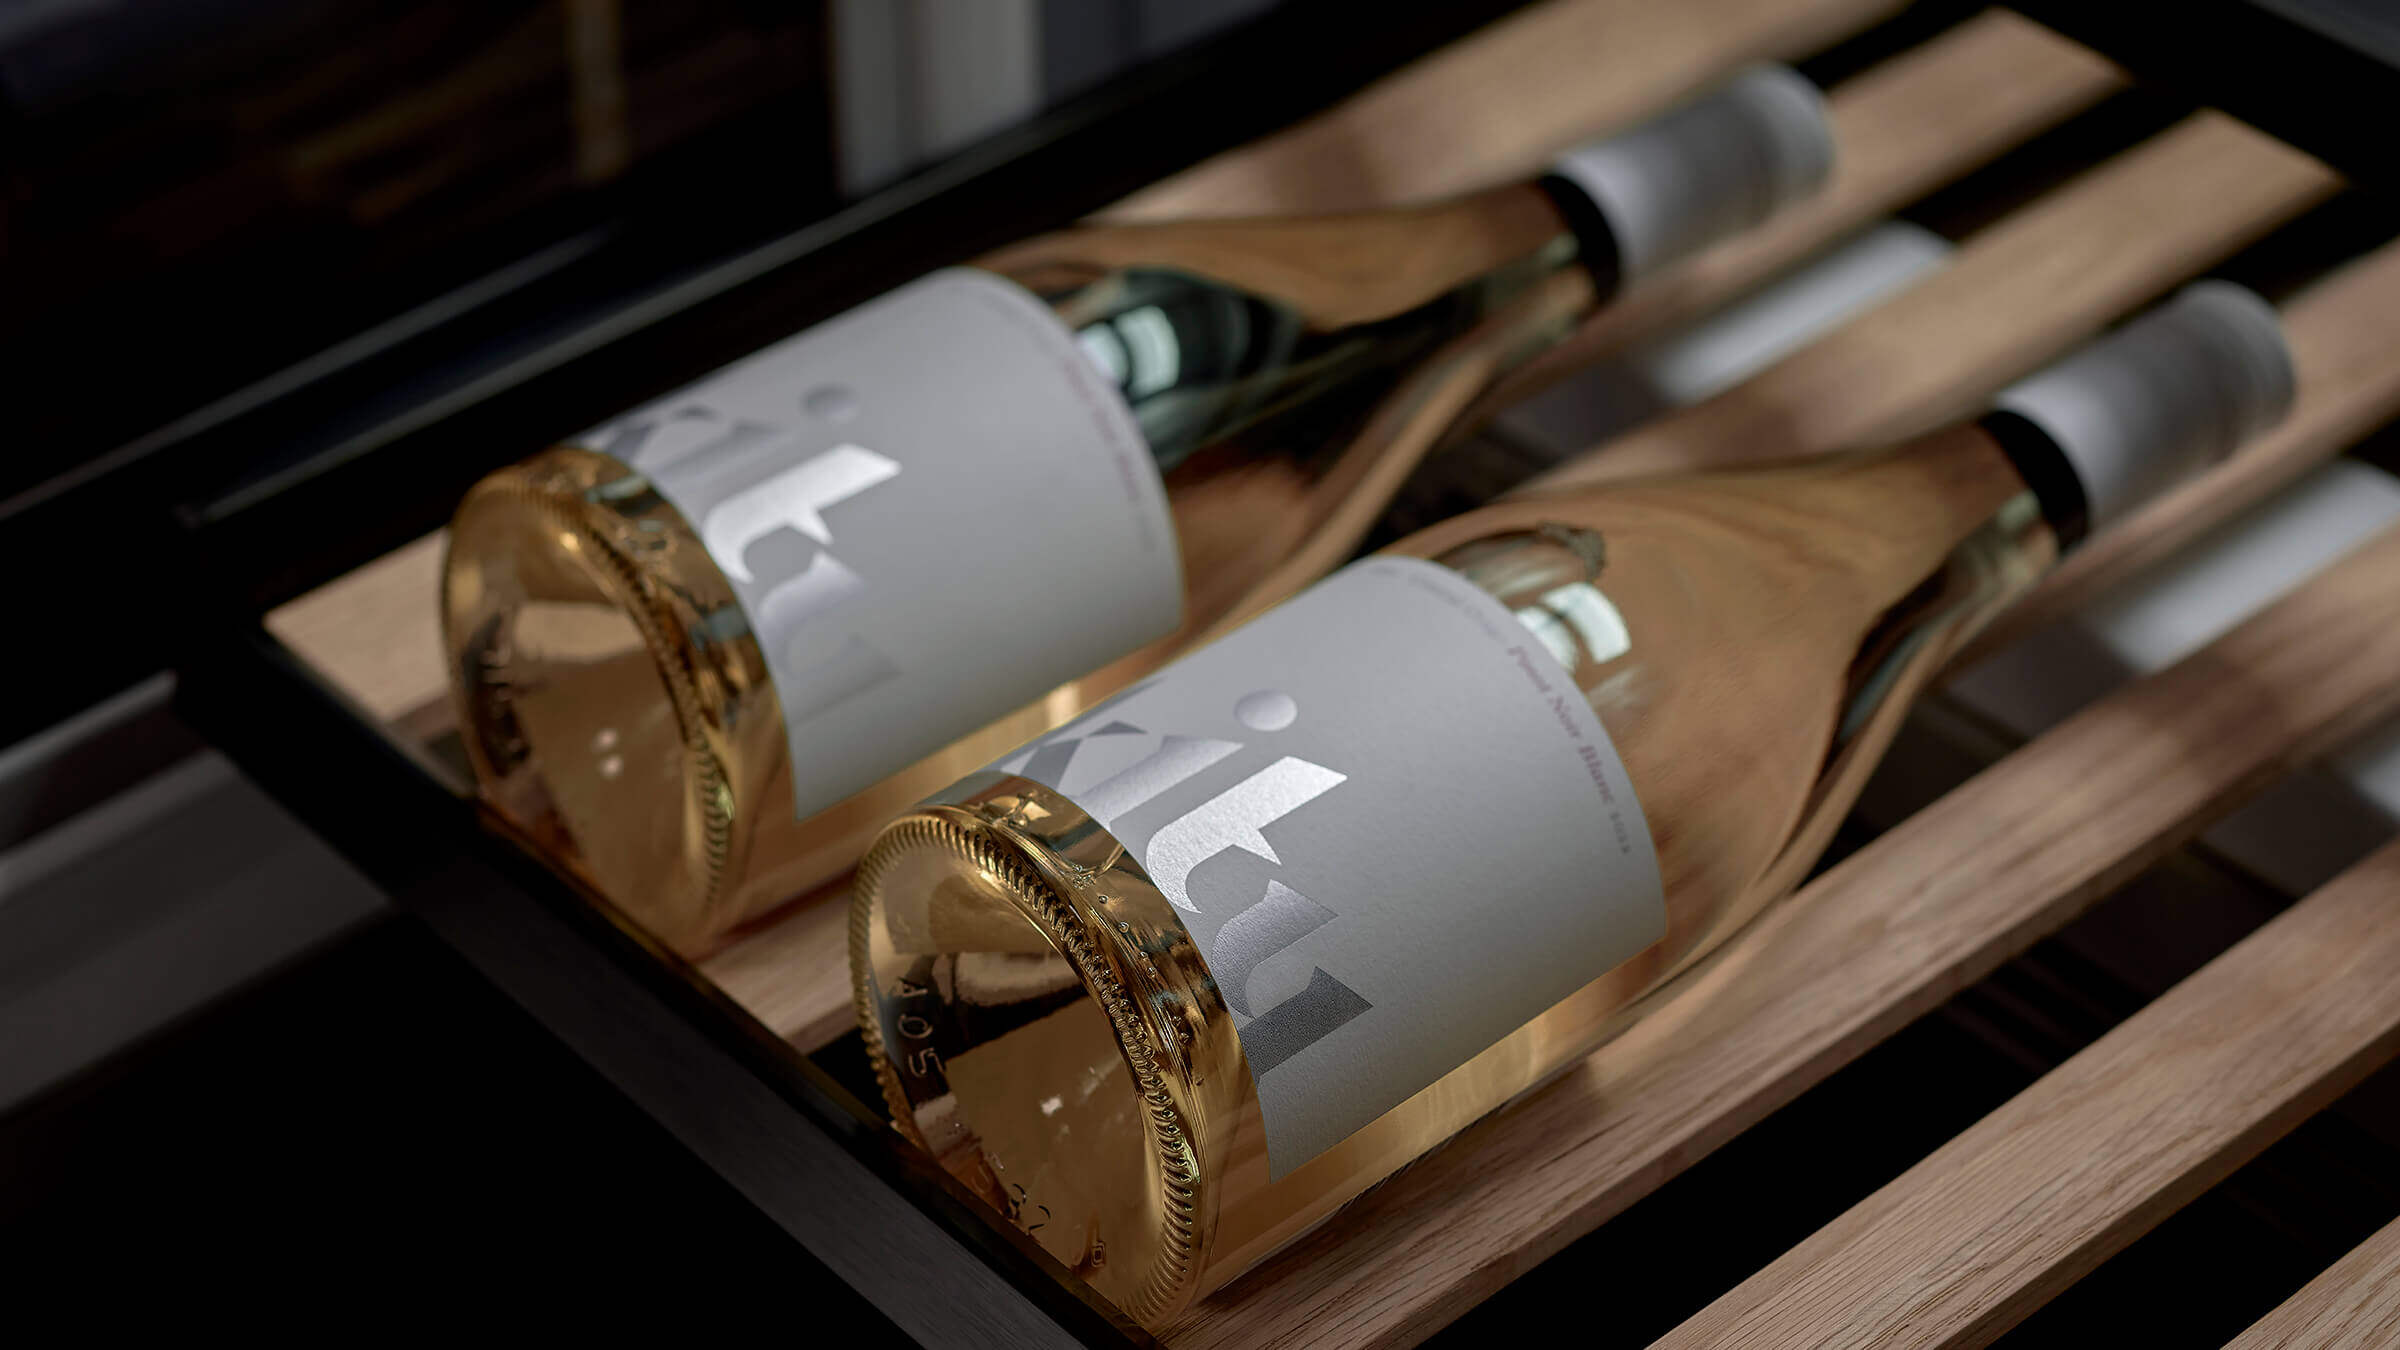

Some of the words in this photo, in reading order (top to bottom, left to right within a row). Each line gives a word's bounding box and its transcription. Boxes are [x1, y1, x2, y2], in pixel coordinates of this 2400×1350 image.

[1508, 645, 1551, 693] Pinot
[1550, 695, 1582, 739] Noir
[1578, 745, 1615, 805] Blanc
